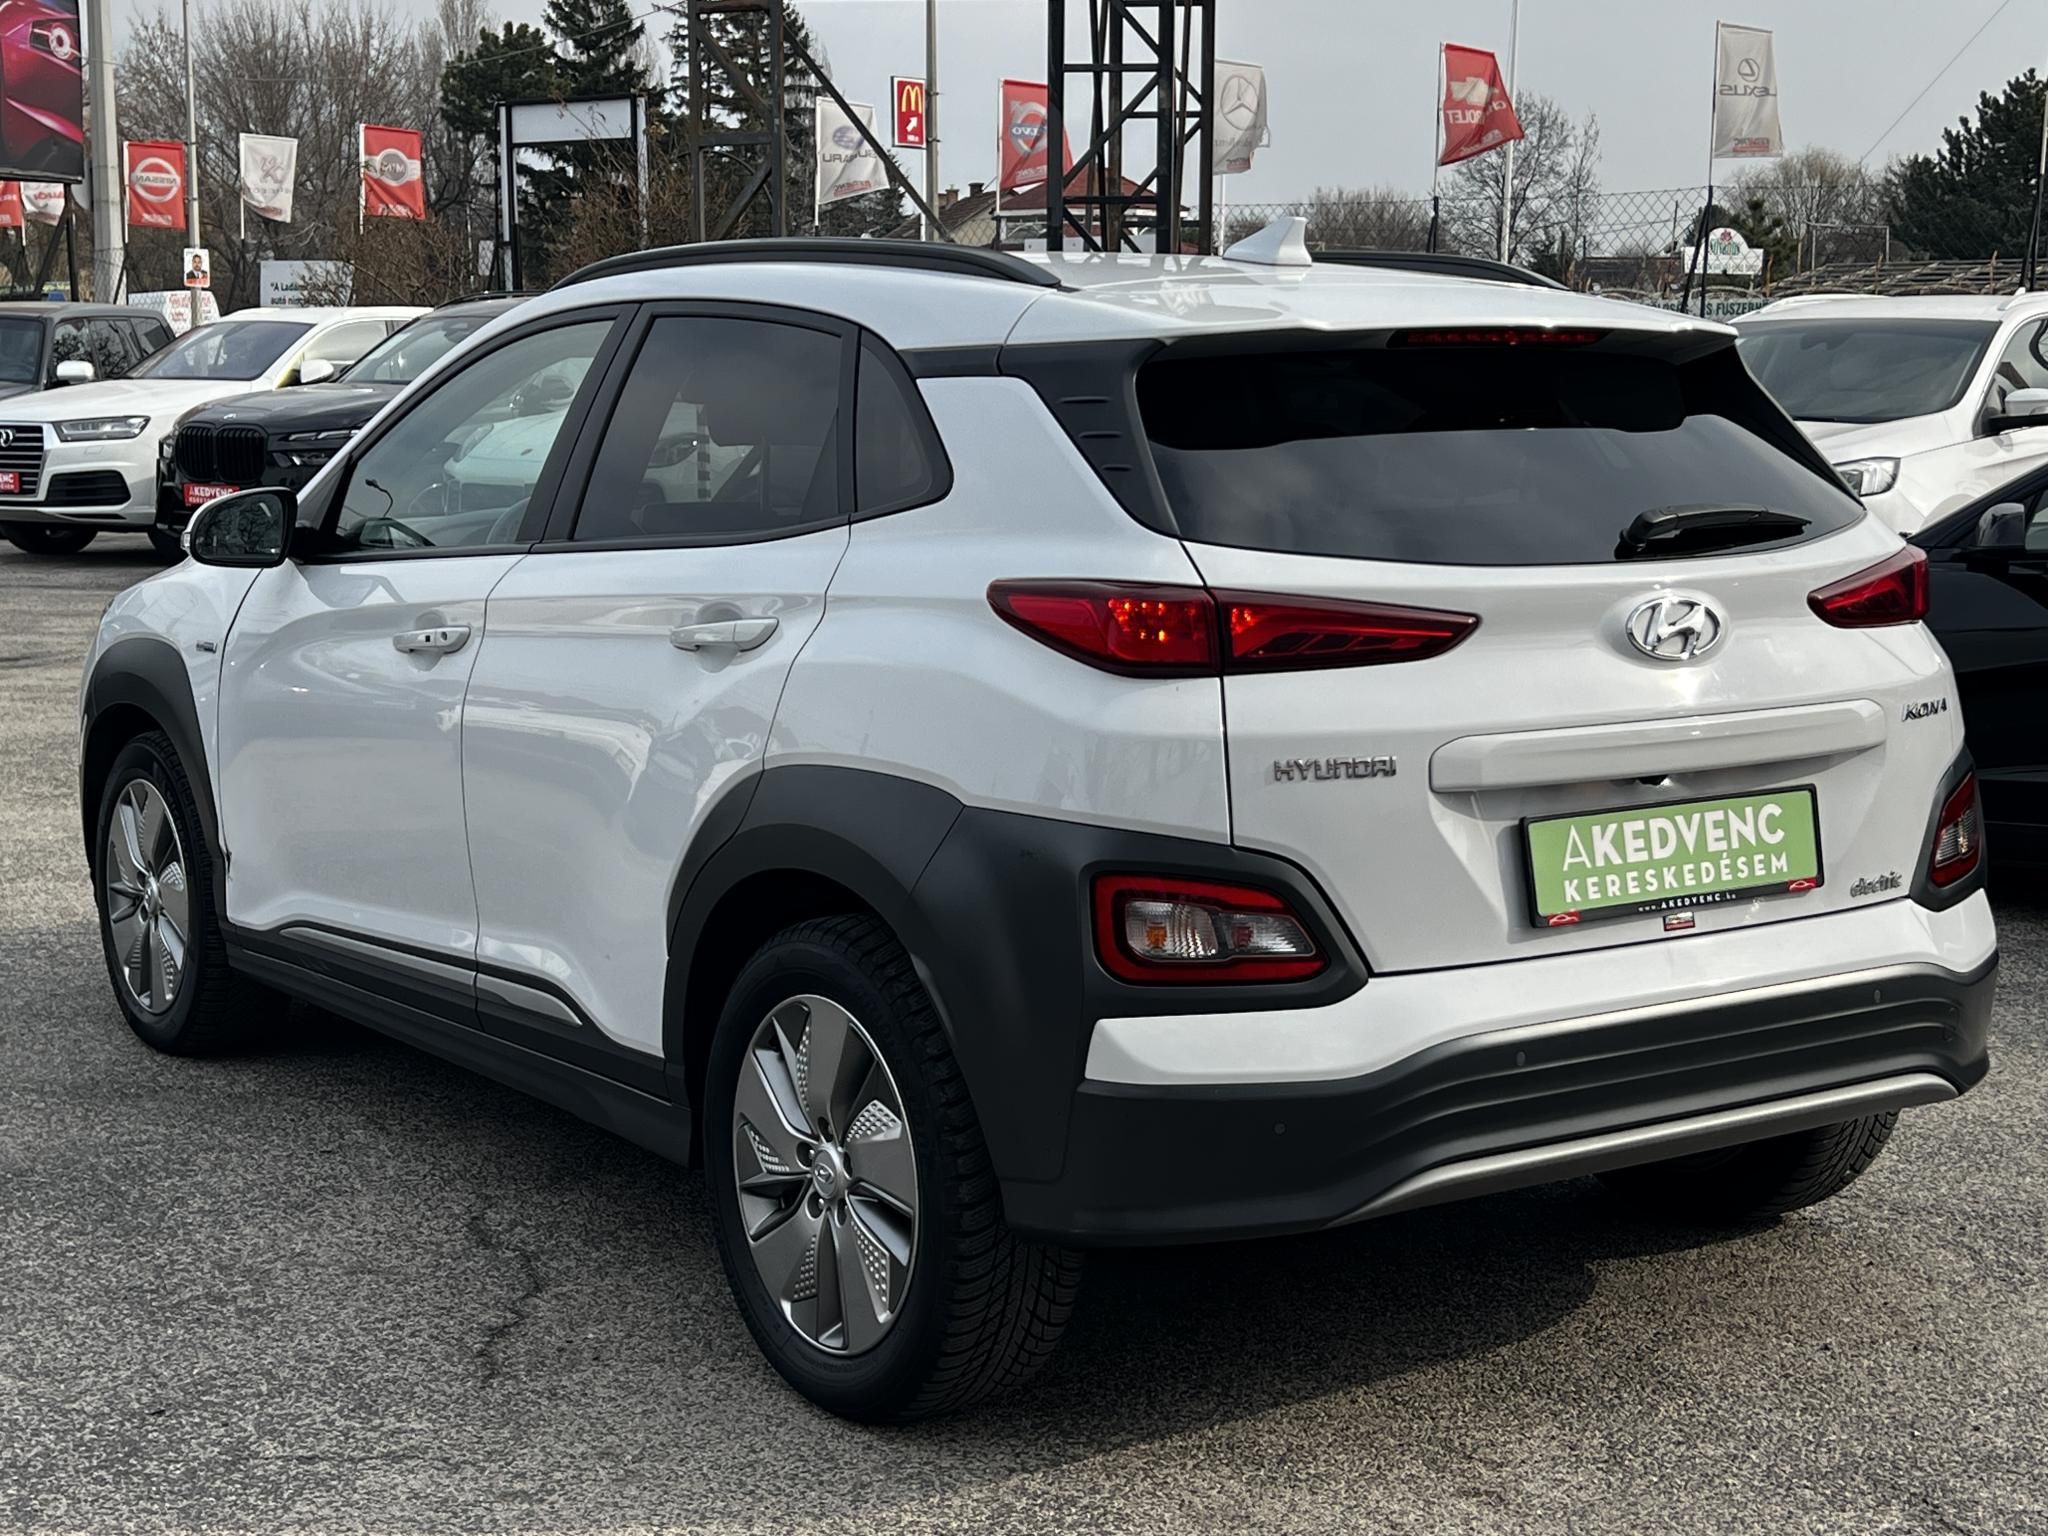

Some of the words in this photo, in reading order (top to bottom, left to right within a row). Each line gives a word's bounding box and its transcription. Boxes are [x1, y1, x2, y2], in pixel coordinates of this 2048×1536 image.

[1272, 756, 1397, 782] HYUNDAI
[1562, 803, 1786, 872] AKEDVENC
[1563, 850, 1789, 903] KERESKEDÉSEM
